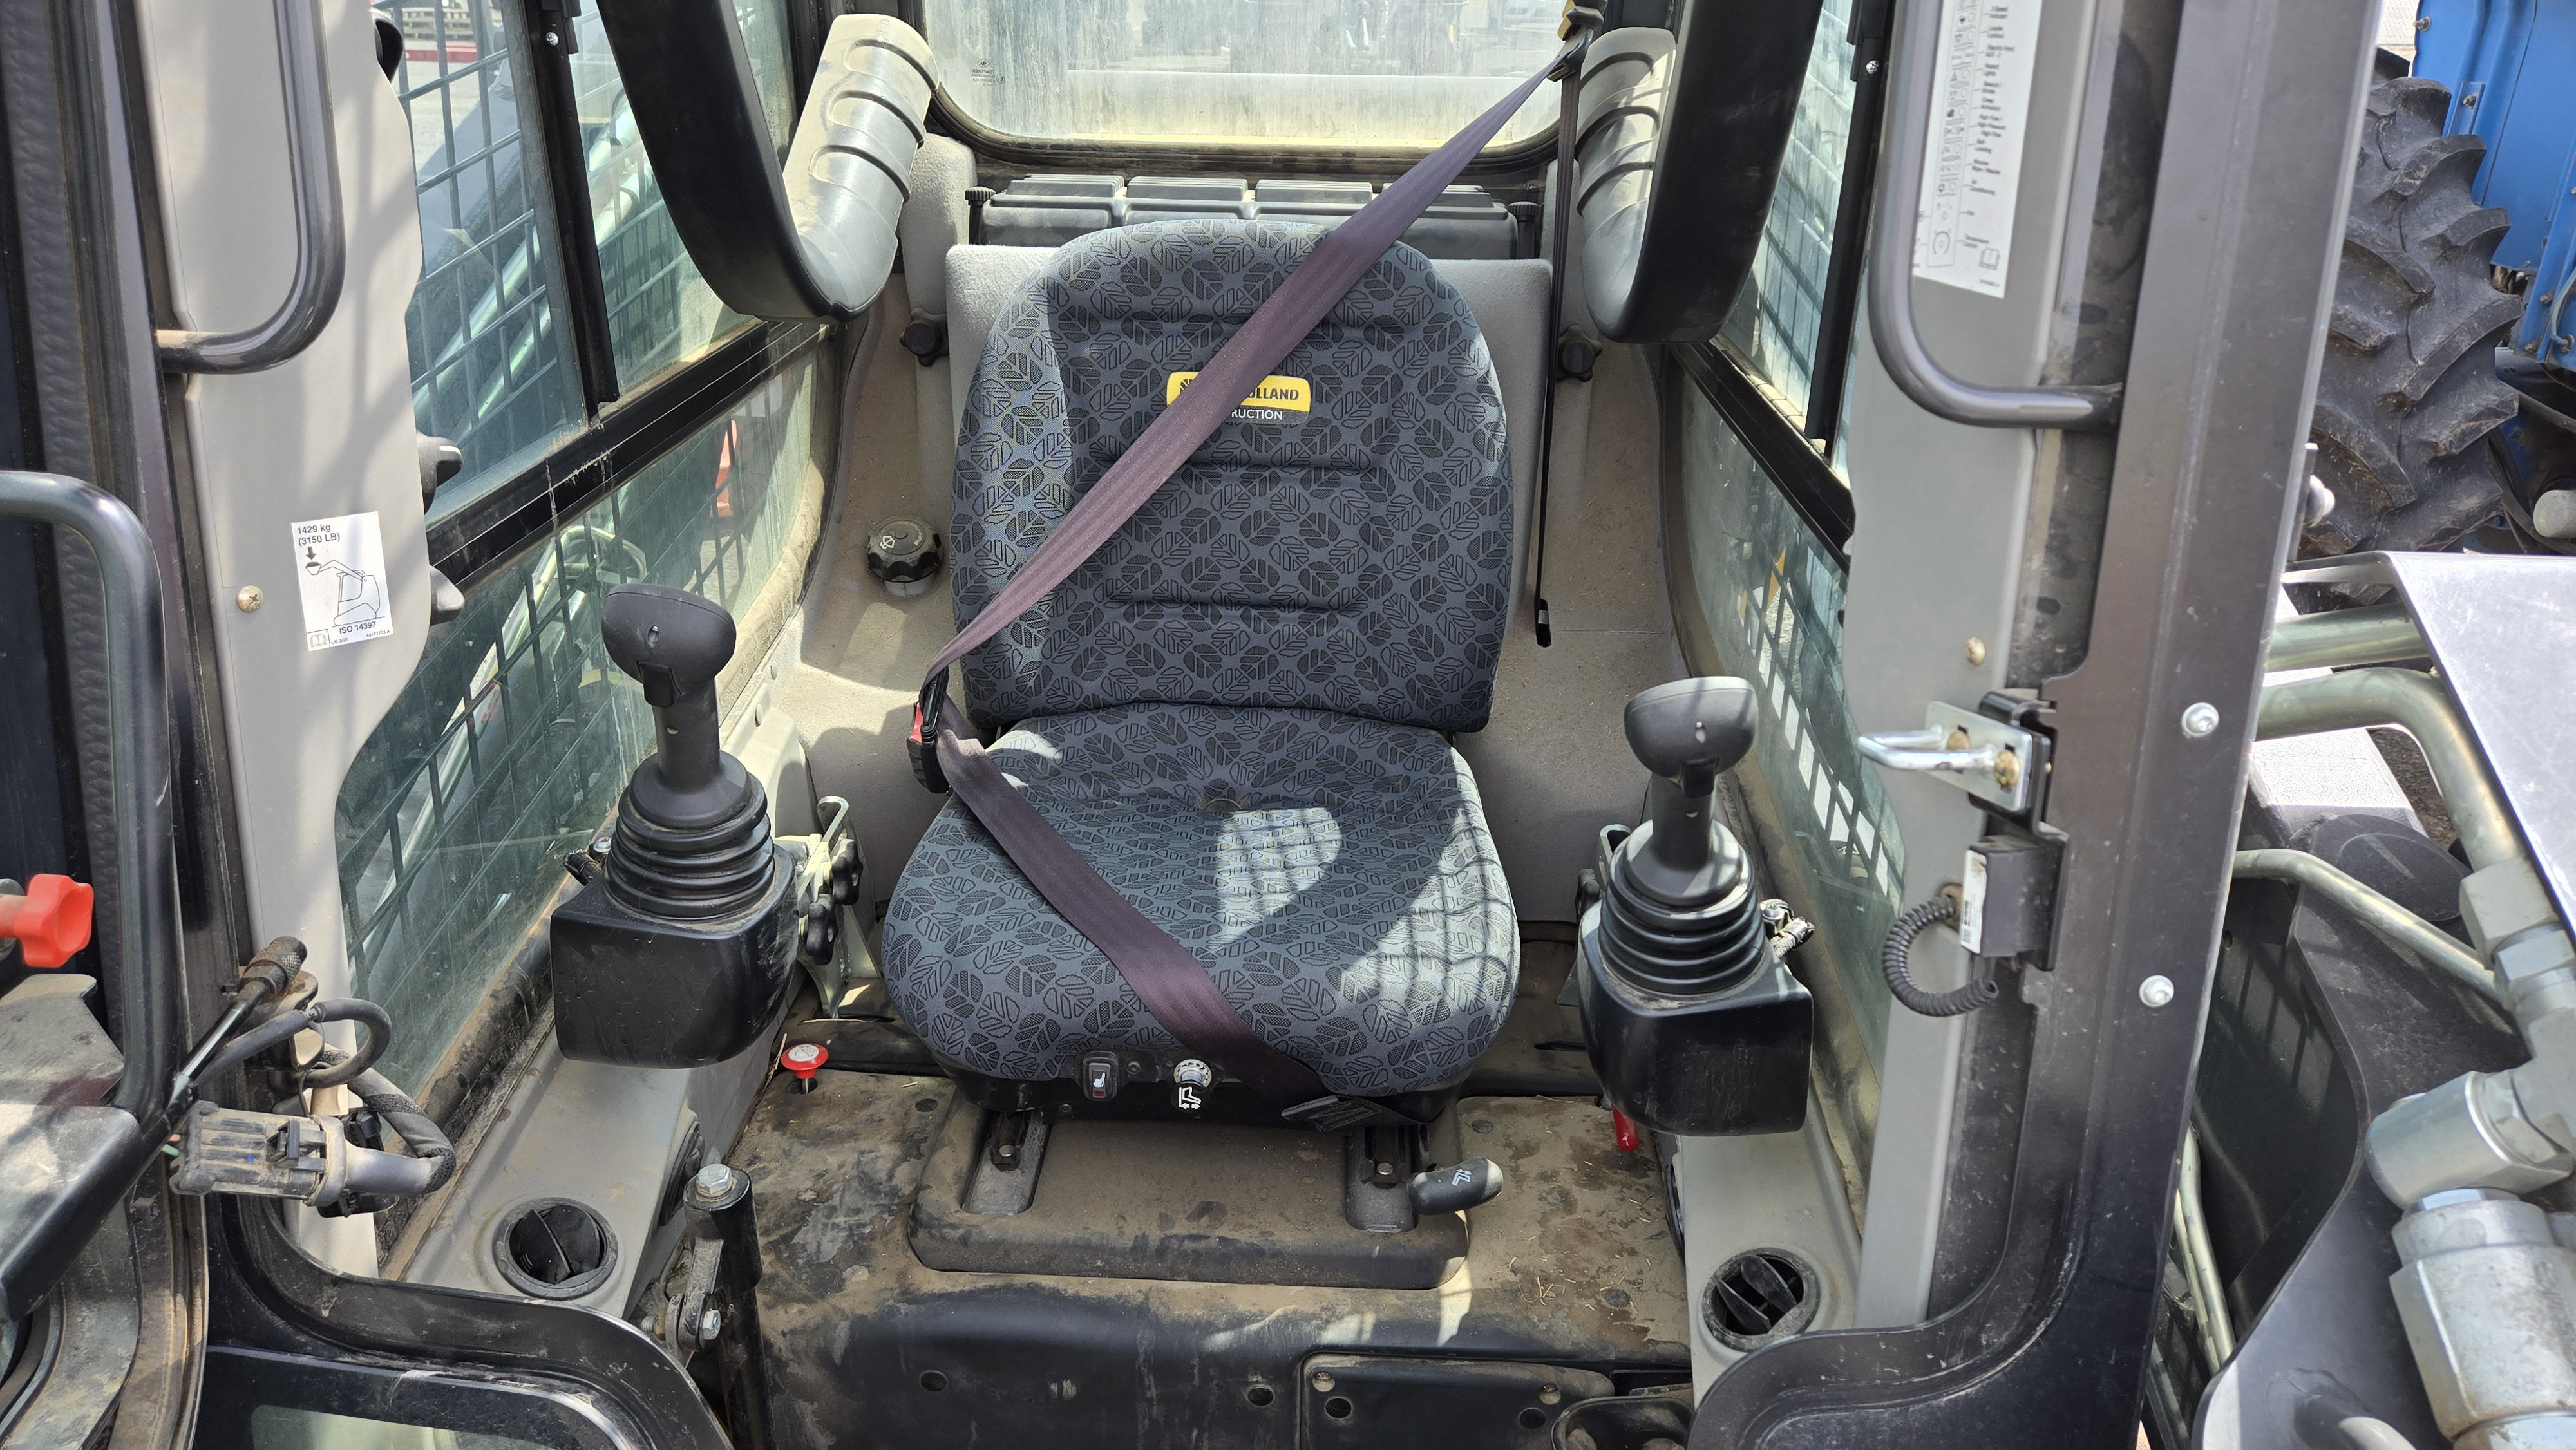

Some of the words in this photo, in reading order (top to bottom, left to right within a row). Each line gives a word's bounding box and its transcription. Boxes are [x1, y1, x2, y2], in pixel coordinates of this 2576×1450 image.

[1231, 409, 1282, 420] RUCTION
[298, 525, 317, 534] 1429
[320, 524, 331, 532] kg
[298, 535, 322, 547] (3150
[325, 532, 340, 542] LB)
[339, 625, 353, 634] ISO
[355, 621, 376, 631] 14397
